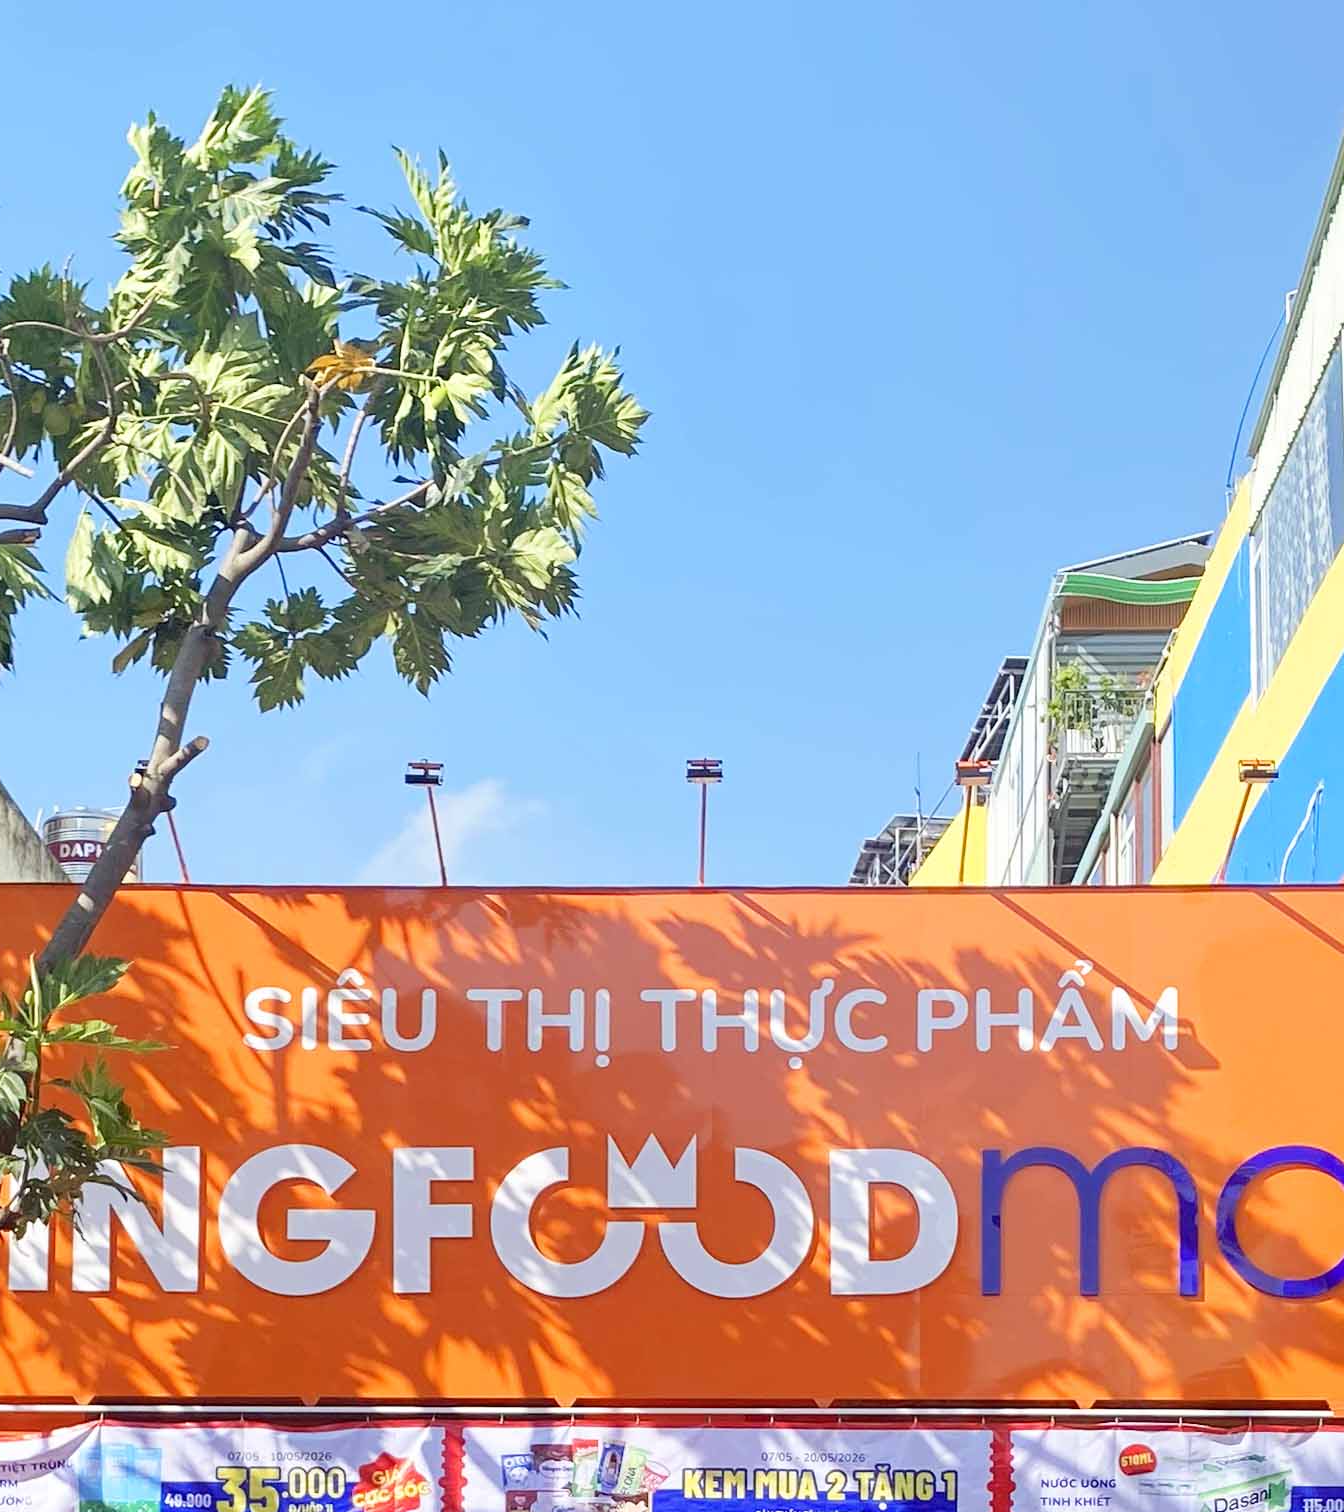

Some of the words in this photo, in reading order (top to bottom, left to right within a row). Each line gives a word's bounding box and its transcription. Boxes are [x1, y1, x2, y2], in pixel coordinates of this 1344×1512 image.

[242, 966, 438, 1053] SIÊU
[466, 987, 611, 1069] THỊ
[640, 978, 888, 1070] THỰC
[916, 959, 1179, 1052] PHẨM
[761, 1452, 793, 1463] 07/05
[803, 1452, 867, 1463] 20/05/2026
[682, 1467, 748, 1501] KEM
[754, 1468, 819, 1501] MUA
[824, 1469, 847, 1502] 2
[853, 1463, 937, 1511] TẶNG
[943, 1470, 958, 1502] 1
[1040, 1477, 1077, 1490] NƯỚC
[1040, 1496, 1072, 1507] TINH
